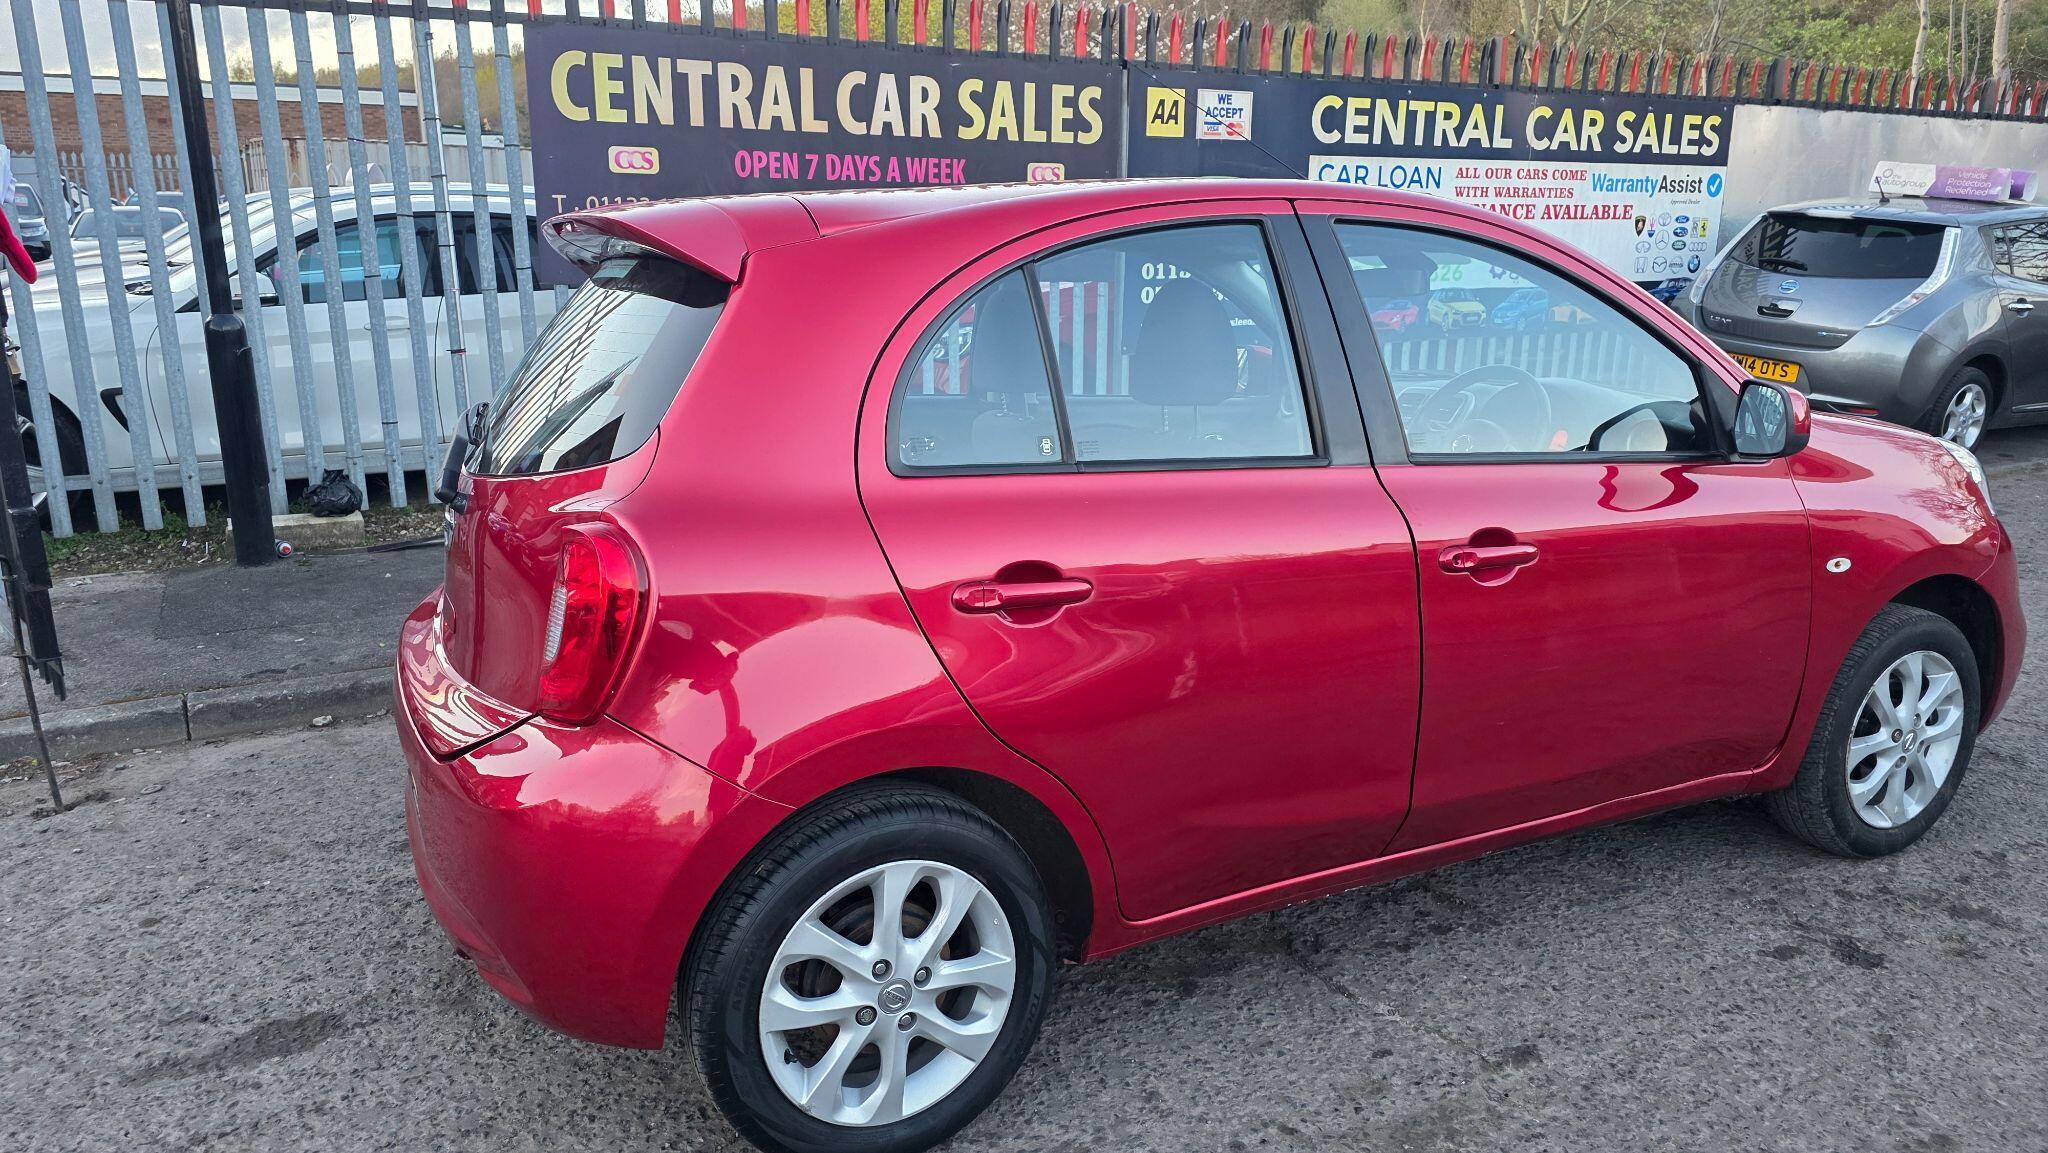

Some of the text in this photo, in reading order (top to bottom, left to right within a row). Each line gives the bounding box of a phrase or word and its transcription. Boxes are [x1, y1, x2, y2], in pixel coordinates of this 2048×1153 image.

[551, 50, 1103, 145] CENTRAL CAR SALES
[1217, 93, 1233, 105] WE
[1151, 98, 1179, 125] AA
[1205, 106, 1244, 119] ACCEPT
[1311, 95, 1722, 157] CENTRAL CAR SALES
[734, 150, 967, 184] OPEN 7 DAYS A WEEK
[1456, 167, 1587, 181] ALL OUR CARS COME
[1318, 163, 1442, 189] CAR LOAN
[1947, 178, 1992, 188] Protection
[1958, 172, 1988, 180] Vehicle
[1455, 186, 1574, 199] WITH WARRANTIES
[1592, 173, 1703, 198] WarrantyAssist
[1945, 186, 1988, 196] Redefined
[1540, 204, 1634, 220] AVAILABLE
[1759, 360, 1790, 378] OTS
